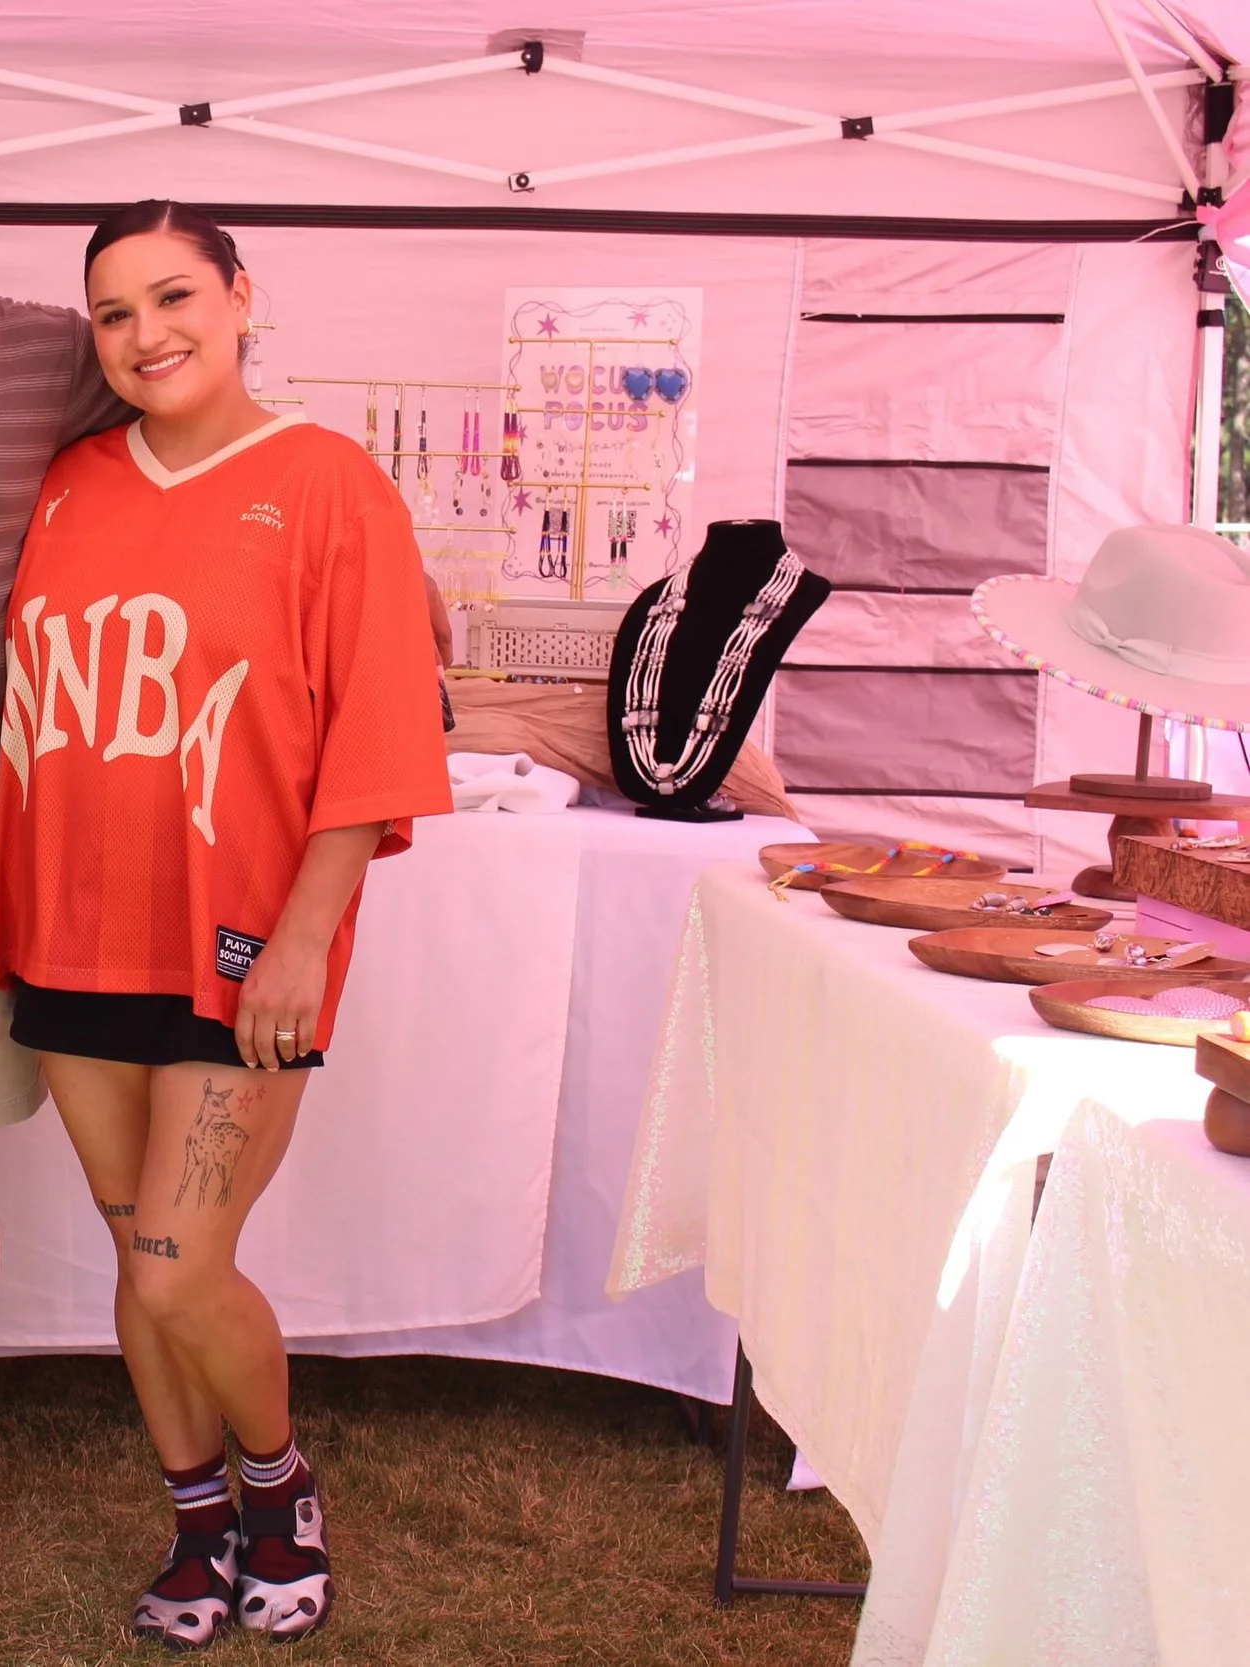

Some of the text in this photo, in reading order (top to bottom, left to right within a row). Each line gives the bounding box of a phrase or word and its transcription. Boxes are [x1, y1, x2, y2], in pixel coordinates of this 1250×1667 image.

[540, 364, 626, 395] WOCU
[544, 401, 648, 432] POCUS
[250, 503, 281, 518] PLAYA
[239, 512, 285, 532] SOCIETY
[225, 938, 252, 954] PLAYA
[219, 949, 255, 967] SOCIETY
